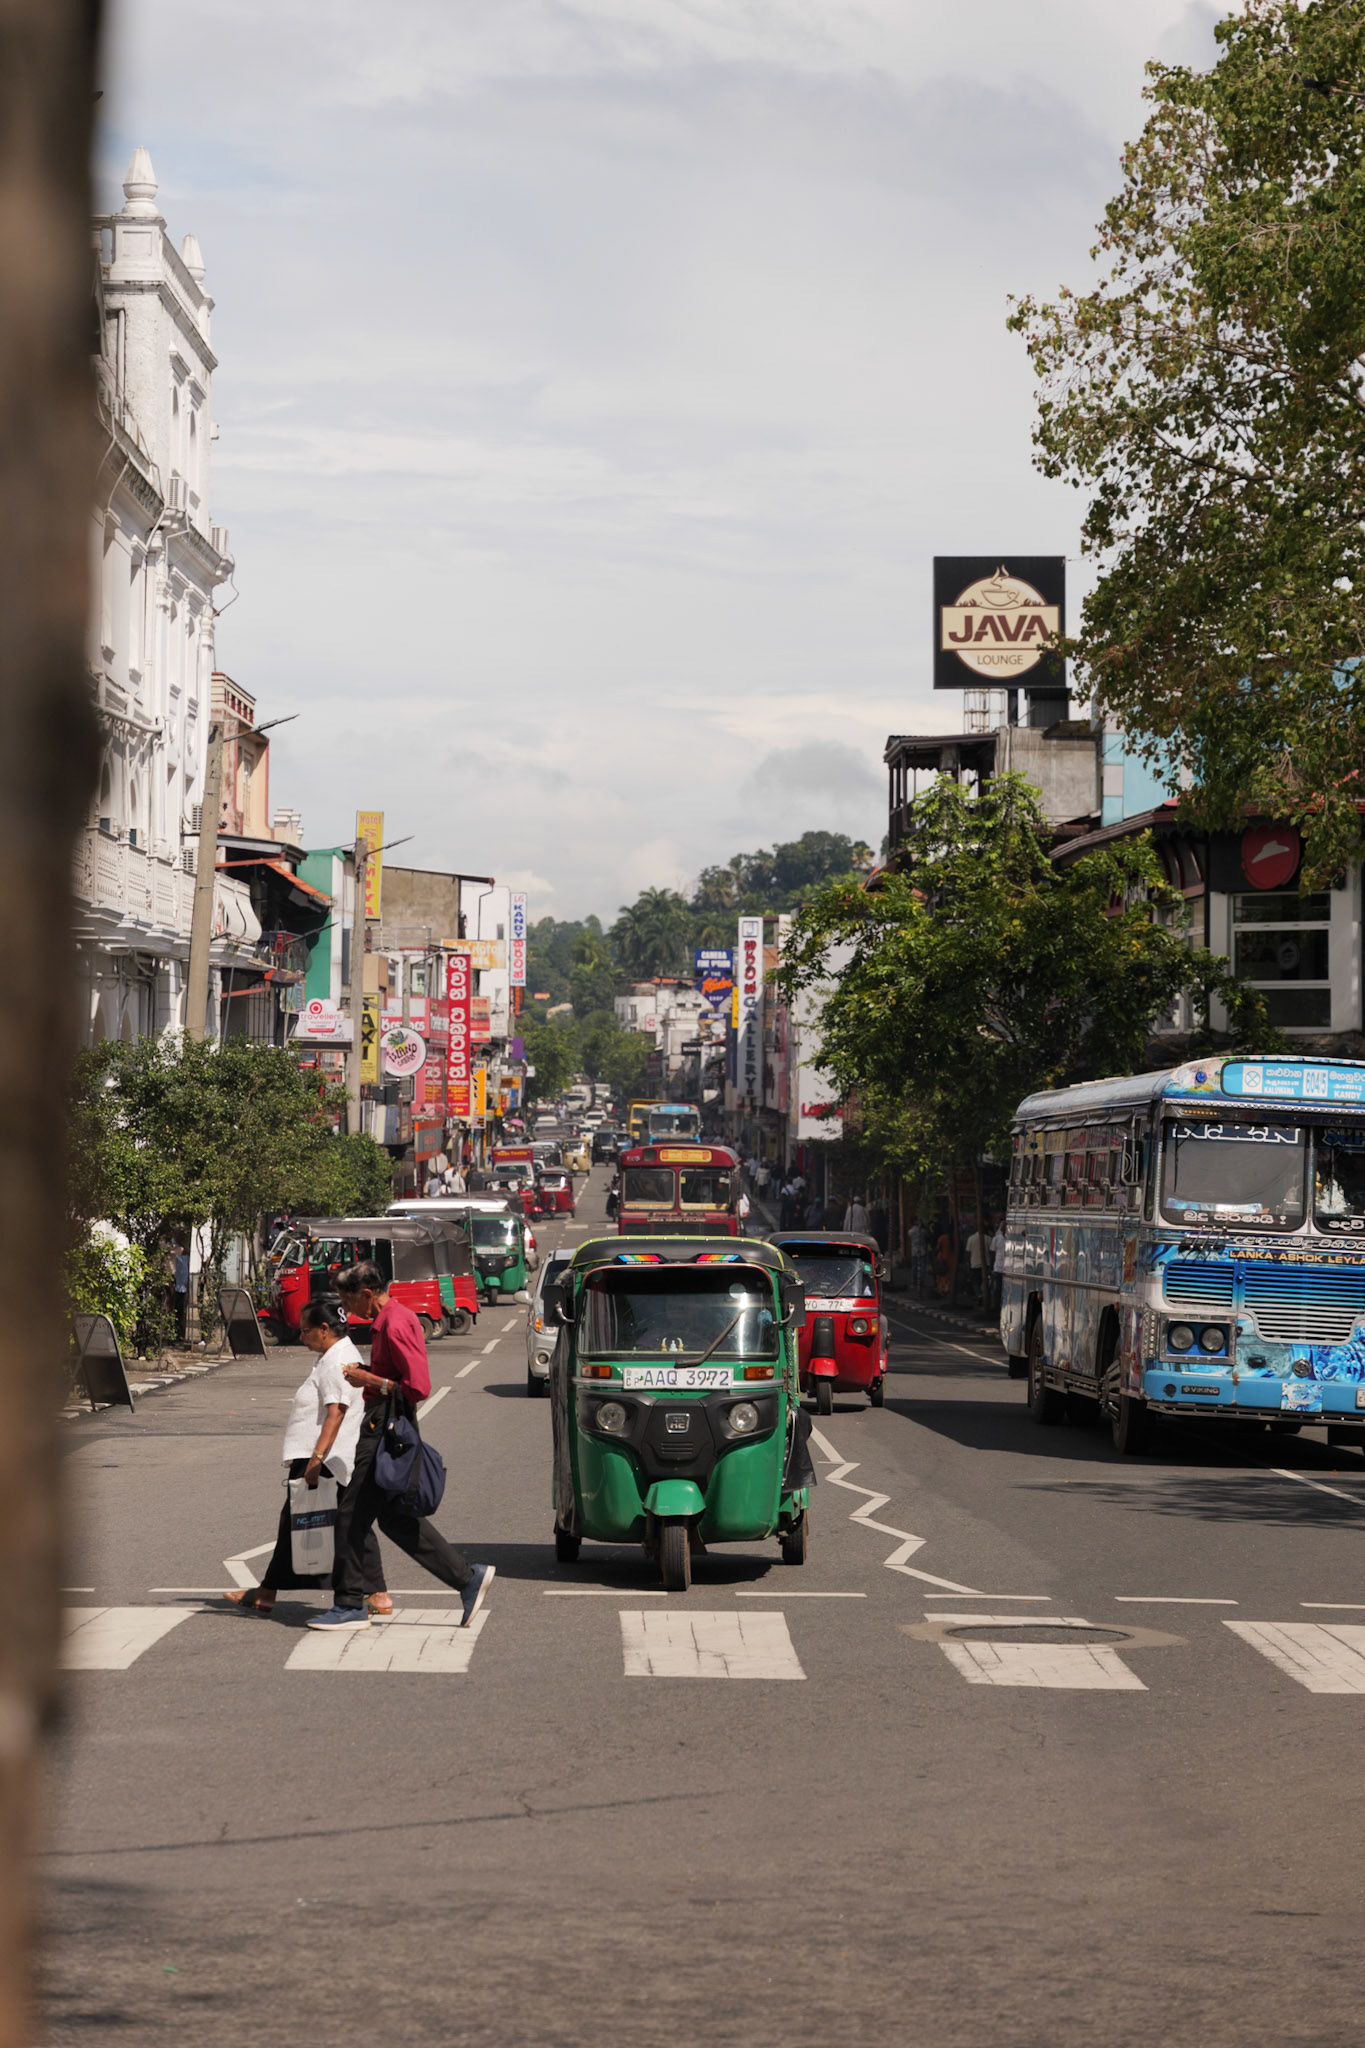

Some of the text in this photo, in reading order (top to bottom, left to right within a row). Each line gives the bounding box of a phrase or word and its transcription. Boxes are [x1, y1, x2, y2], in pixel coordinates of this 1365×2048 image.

[948, 614, 1053, 643] JAVA
[977, 655, 1023, 665] LOUNGE
[514, 904, 523, 937] KANDY
[362, 997, 375, 1060] TAXI
[743, 996, 757, 1089] GALLERY
[1334, 1090, 1361, 1099] KANDY
[1184, 1211, 1209, 1222] බුදු
[1229, 1250, 1273, 1260] LANKA
[1279, 1252, 1323, 1262] ASHOK
[644, 1370, 678, 1385] AAQ
[686, 1370, 729, 1385] 3972
[1190, 1386, 1219, 1394] VIKING
